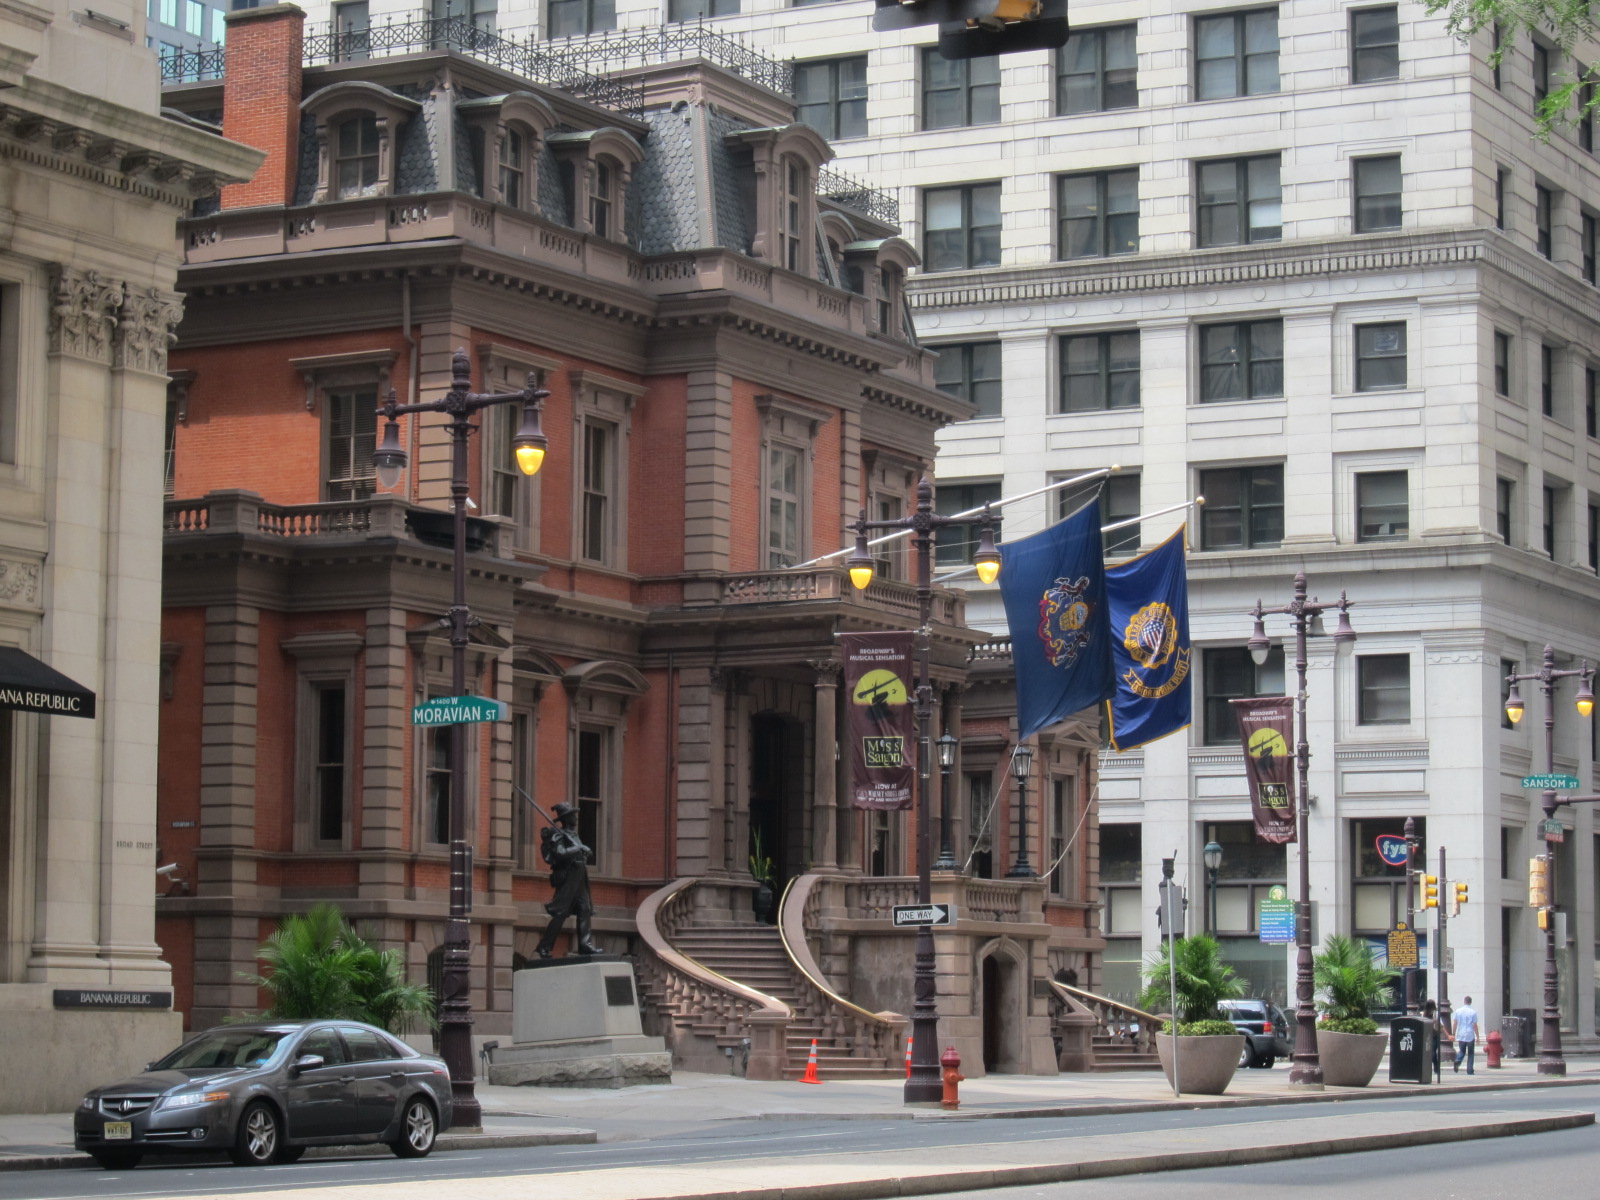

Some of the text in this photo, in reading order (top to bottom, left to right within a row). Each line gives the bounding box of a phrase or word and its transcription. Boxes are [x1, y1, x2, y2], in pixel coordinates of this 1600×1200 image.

[26, 692, 80, 711] REPUBLIC
[451, 697, 458, 705] W
[414, 706, 496, 723] MORAVIAN ST
[867, 751, 900, 766] Saigon
[1523, 779, 1566, 788] SANSOM
[899, 911, 932, 920] ONE WAY
[80, 993, 151, 1004] BANANA REPUBLIC
